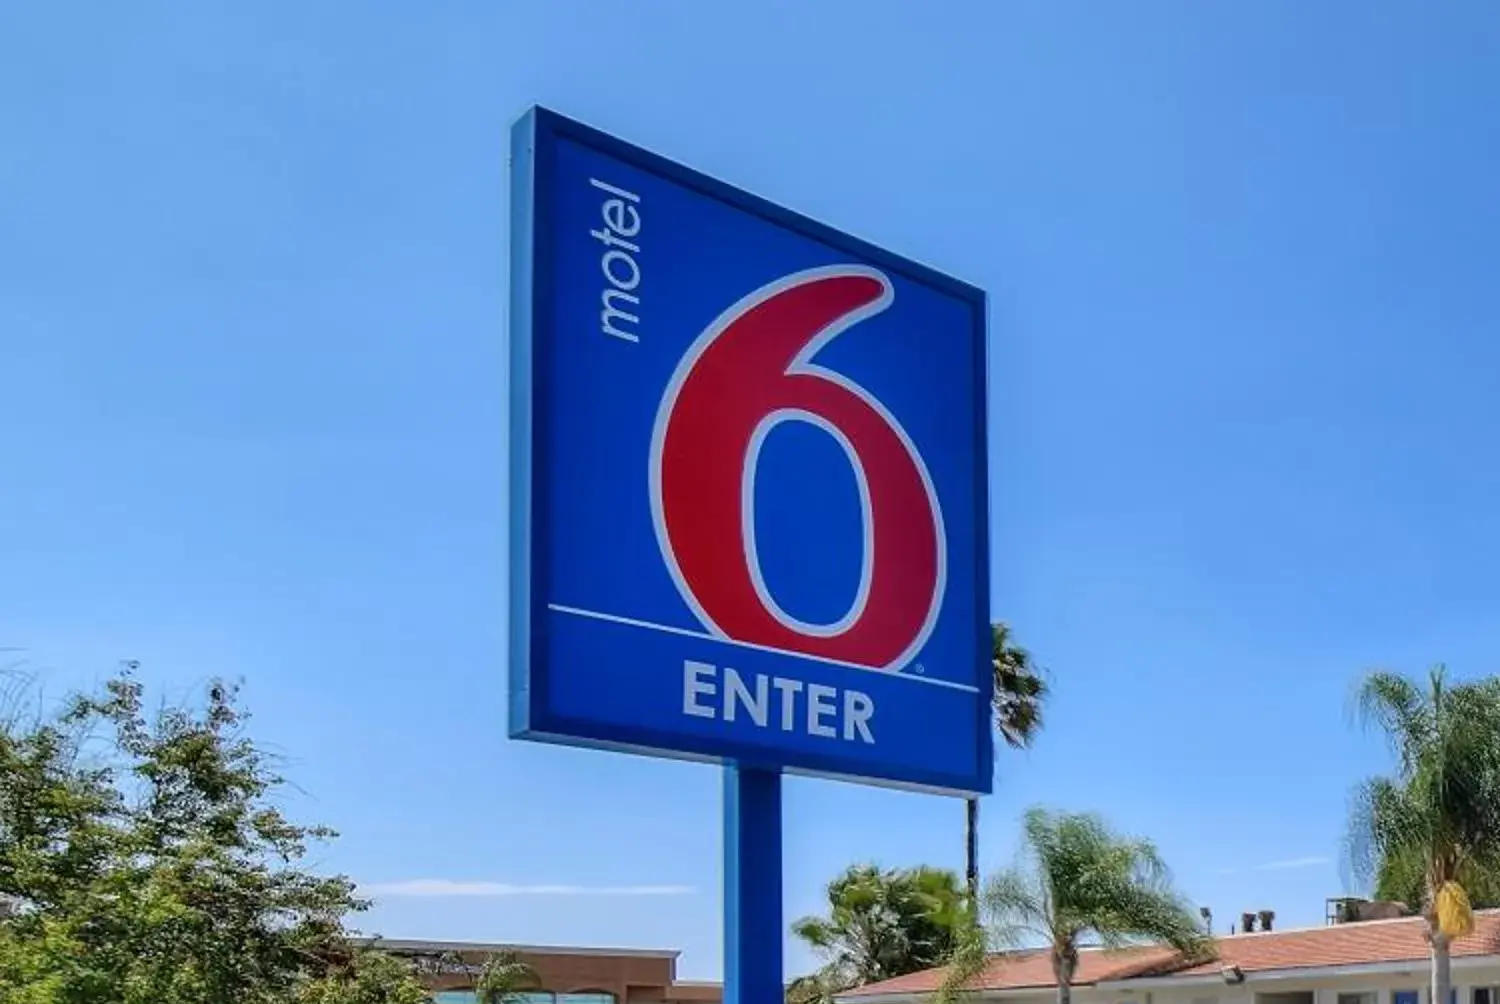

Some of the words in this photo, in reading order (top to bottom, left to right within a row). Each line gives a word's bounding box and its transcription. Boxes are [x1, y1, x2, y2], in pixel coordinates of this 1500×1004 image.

[589, 177, 640, 343] motel
[648, 263, 947, 674] 6
[683, 659, 876, 744] ENTER
